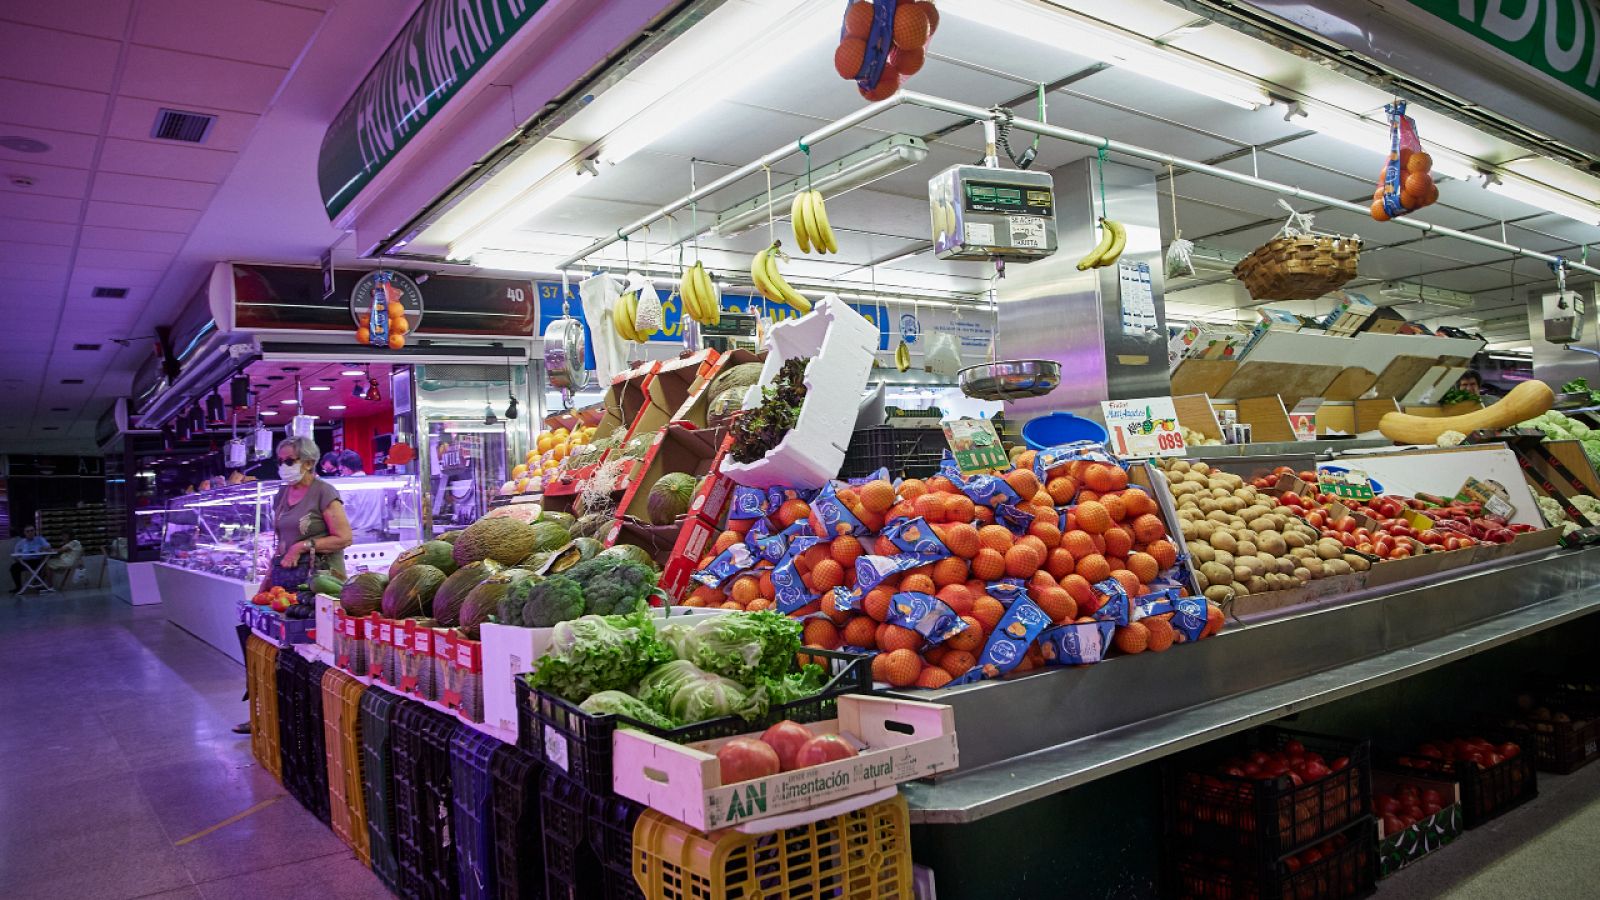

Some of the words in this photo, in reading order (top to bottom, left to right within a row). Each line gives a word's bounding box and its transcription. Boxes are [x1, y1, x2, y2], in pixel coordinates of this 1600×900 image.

[507, 287, 524, 302] 40
[542, 285, 559, 299] 37
[774, 770, 850, 801] Alimentación
[853, 756, 893, 783] Natural
[726, 781, 767, 822] AN
